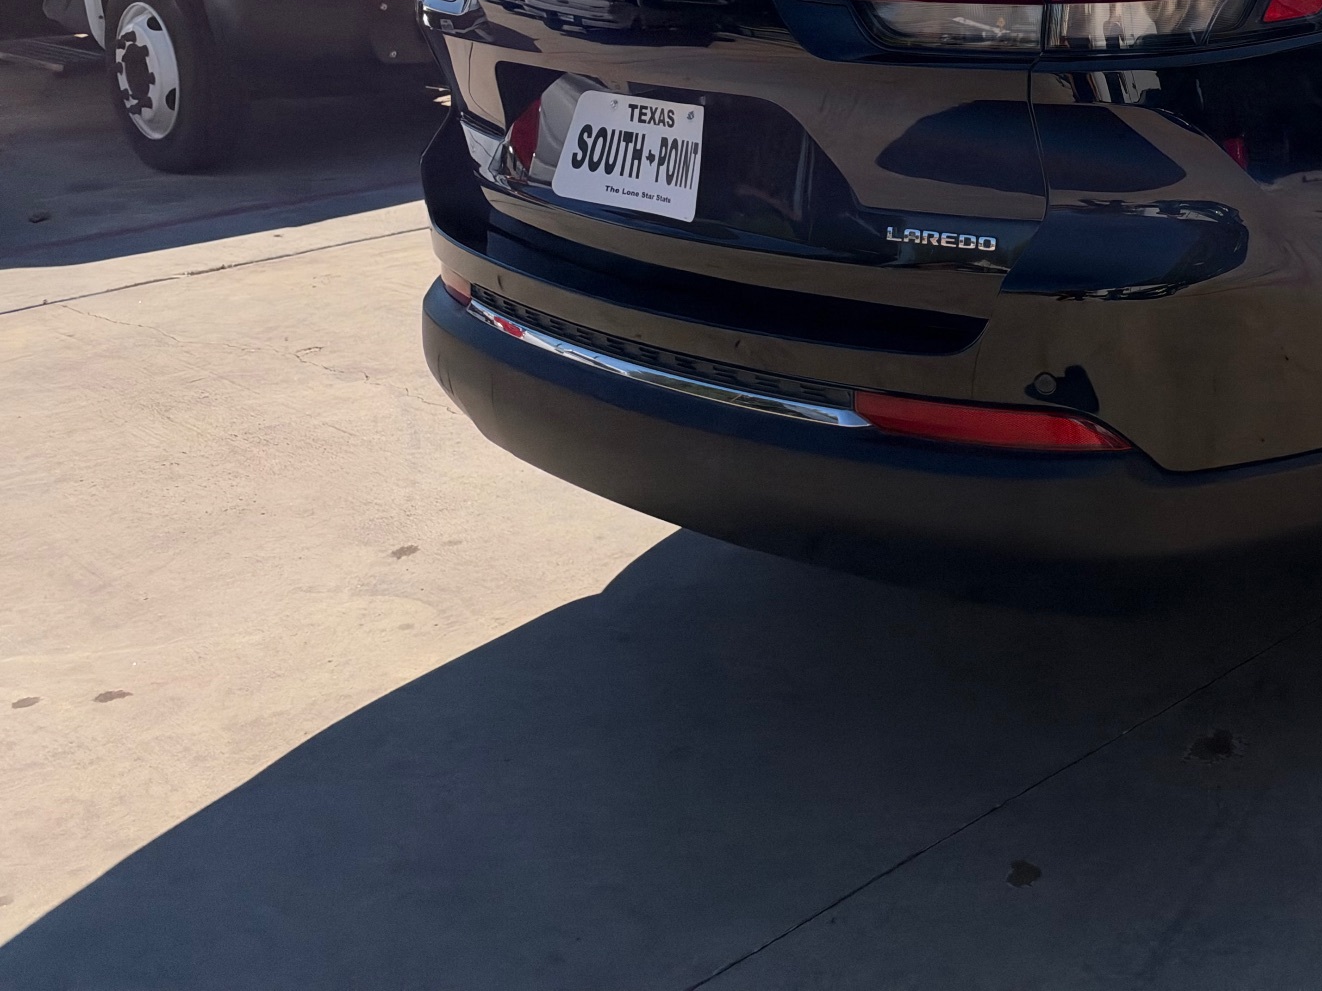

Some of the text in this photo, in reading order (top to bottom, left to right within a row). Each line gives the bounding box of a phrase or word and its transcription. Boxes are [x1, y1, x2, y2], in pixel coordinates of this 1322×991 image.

[628, 103, 675, 129] TEXAS
[571, 123, 699, 190] SOUTH POINT
[605, 185, 620, 194] The
[622, 188, 640, 198] Lone
[641, 191, 654, 200] Star
[886, 226, 997, 251] LAREDO
